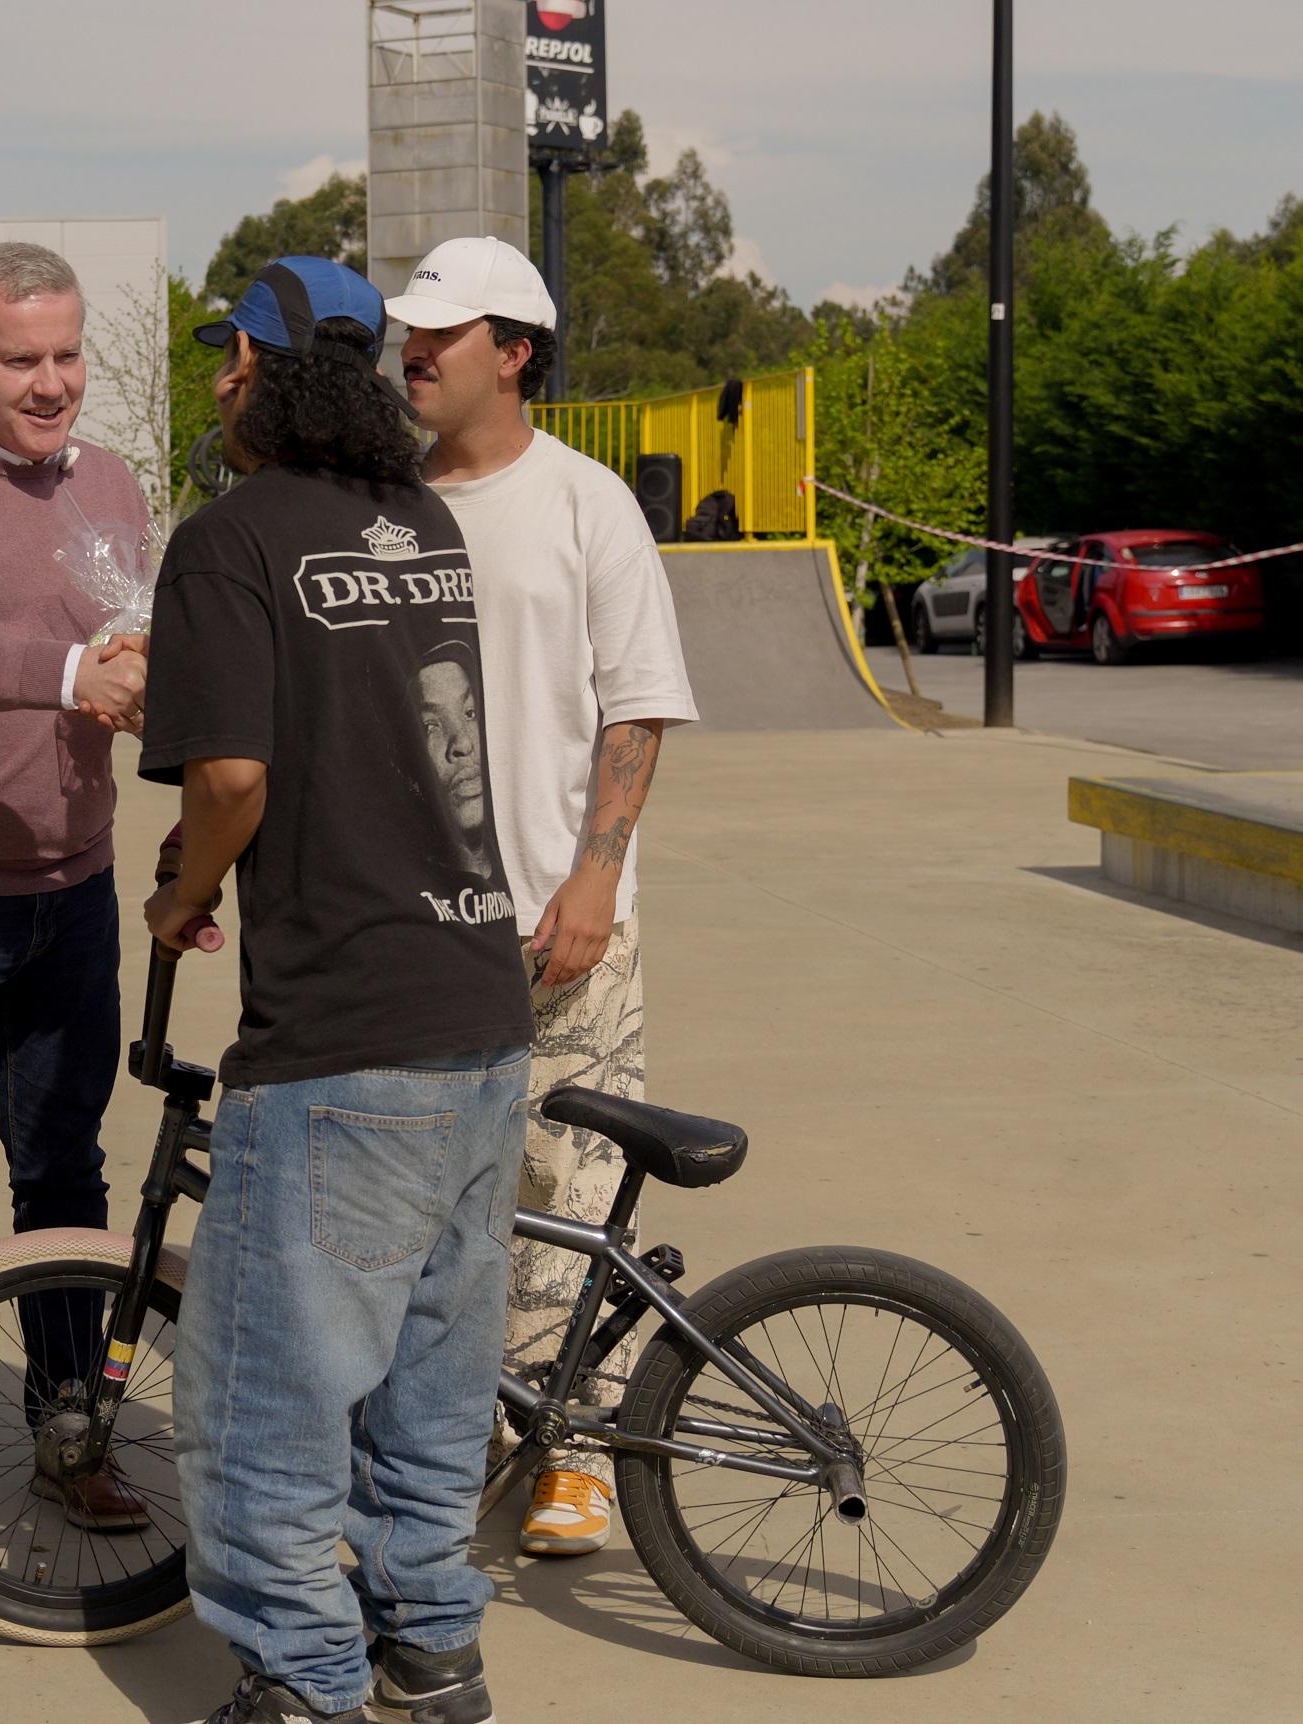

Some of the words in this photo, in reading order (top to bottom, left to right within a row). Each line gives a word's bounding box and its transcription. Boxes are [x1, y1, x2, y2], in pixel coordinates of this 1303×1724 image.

[525, 35, 593, 64] REPSOL
[311, 571, 402, 608] DR.
[399, 568, 473, 604] DRE
